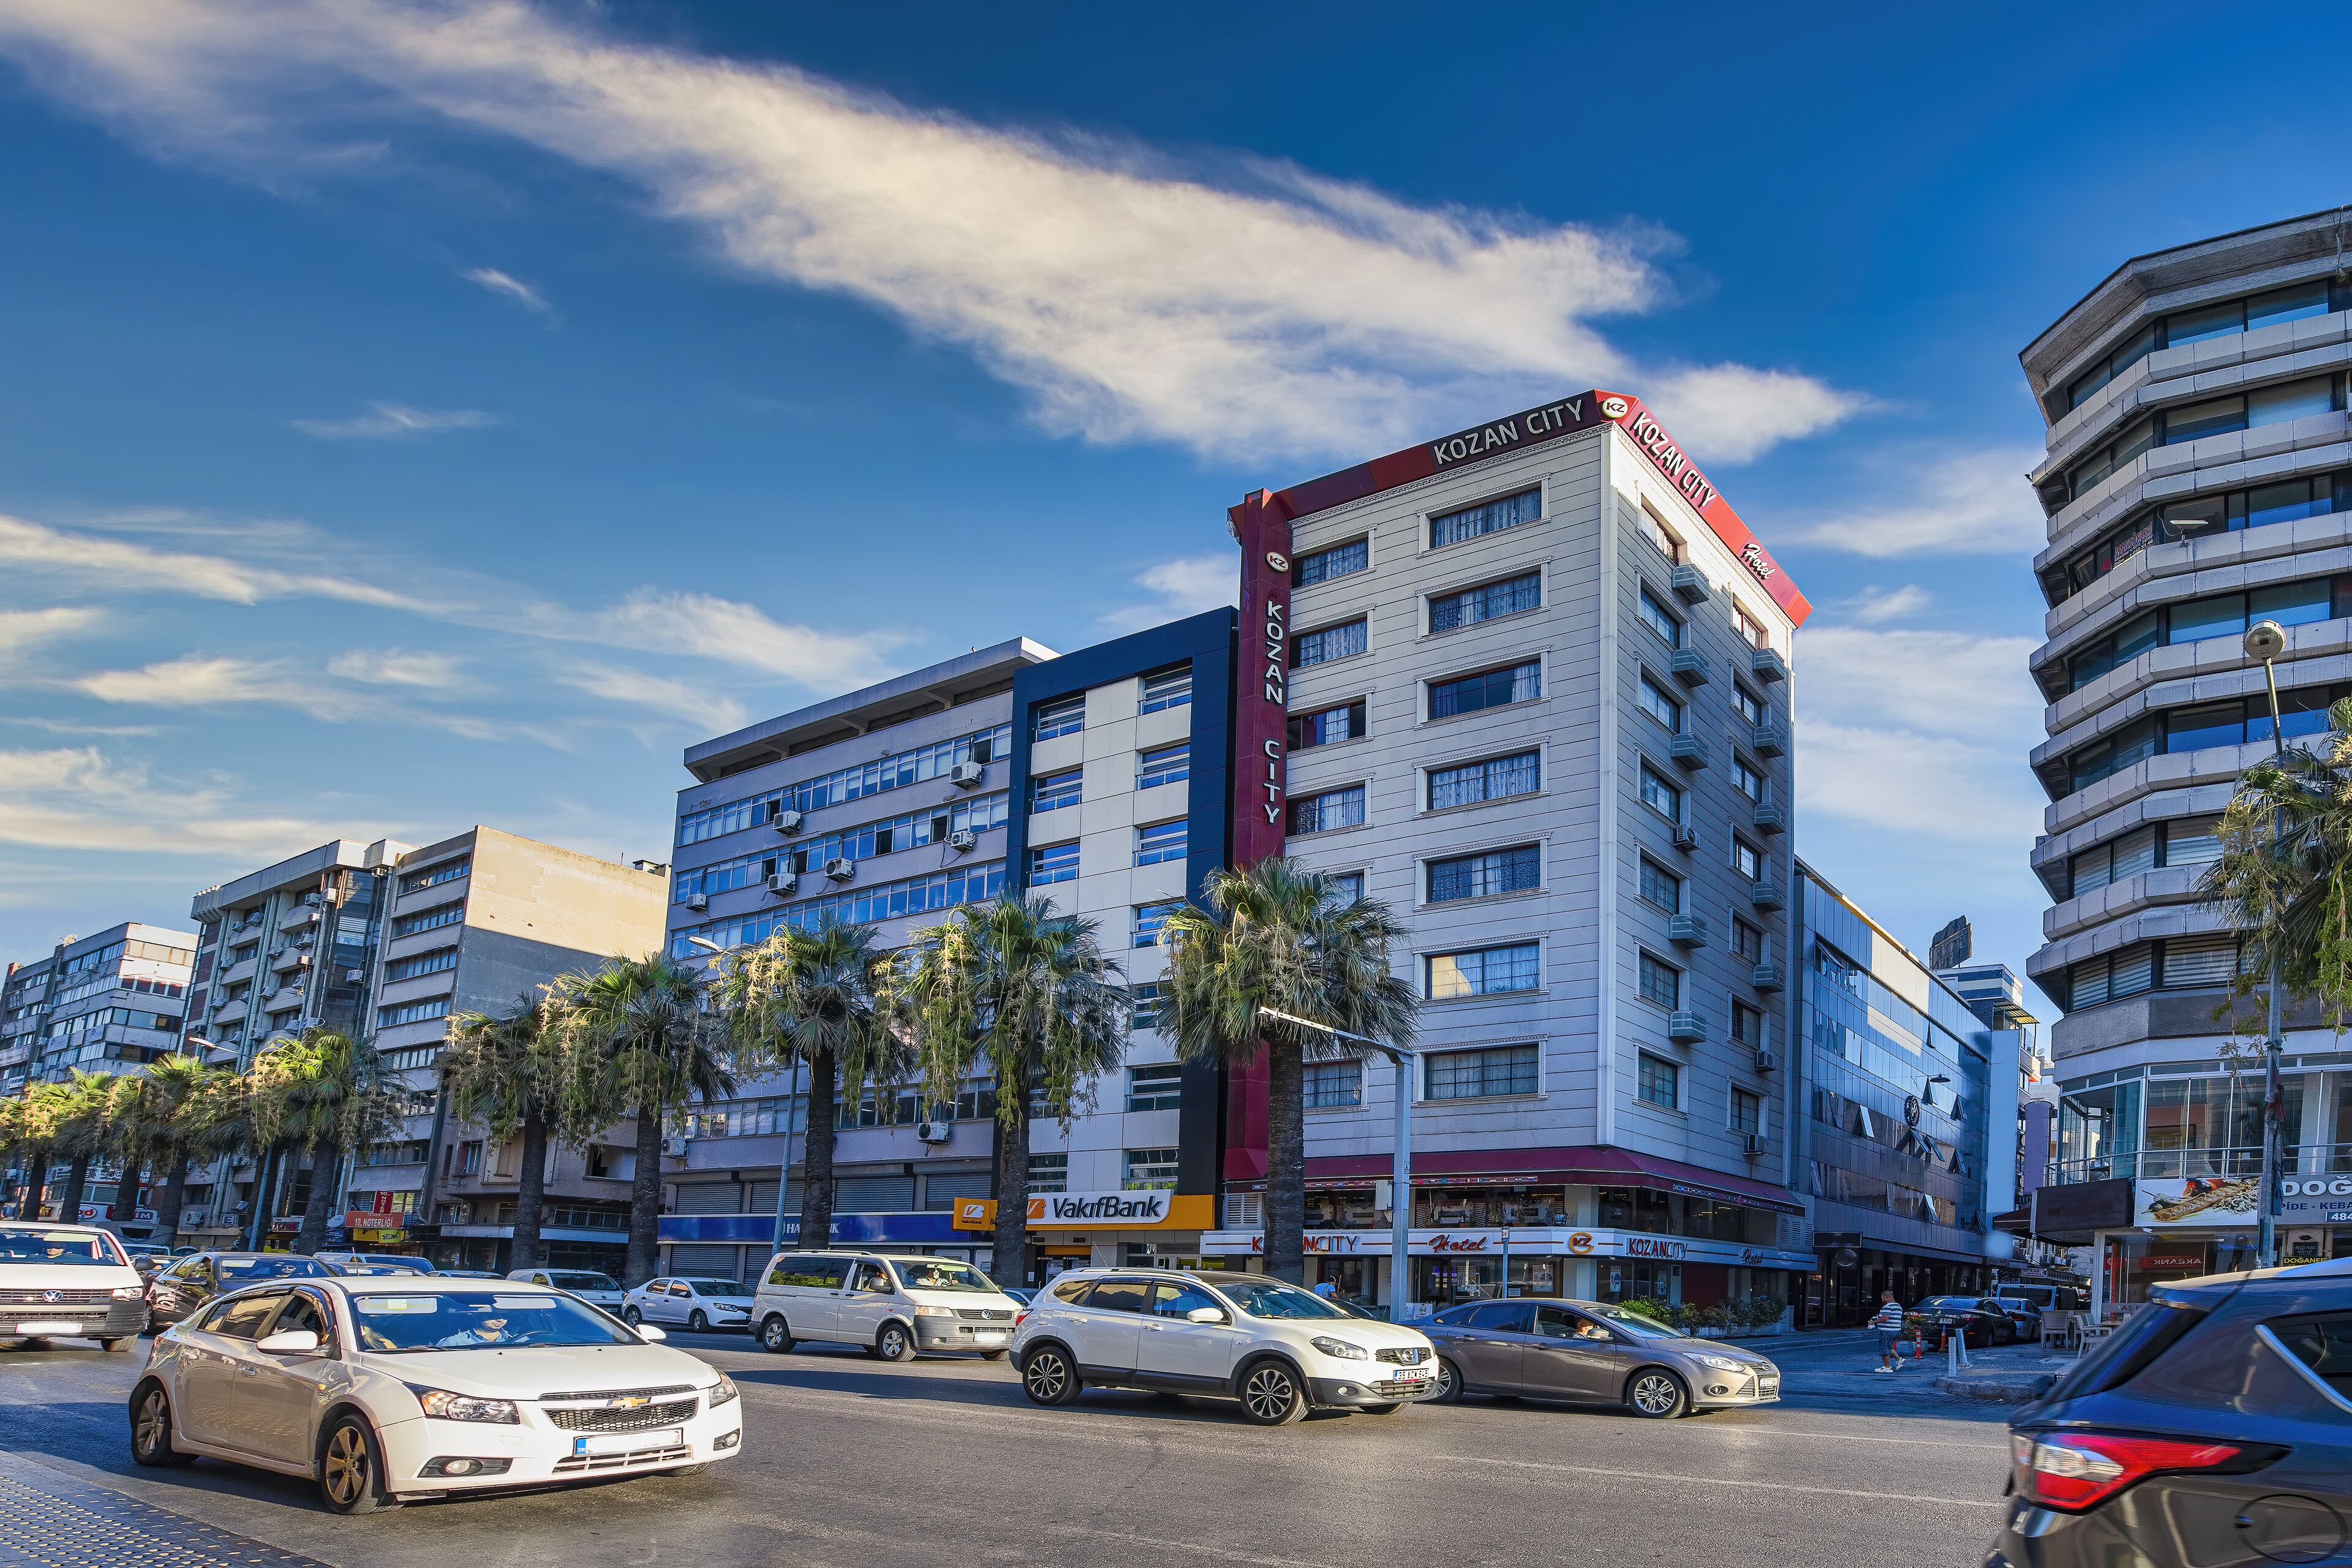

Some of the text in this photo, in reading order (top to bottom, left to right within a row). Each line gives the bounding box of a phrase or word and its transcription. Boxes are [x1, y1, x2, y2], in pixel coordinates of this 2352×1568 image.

[1606, 401, 1626, 413] KZ
[1433, 399, 1582, 465] KOZAN CITY
[1630, 411, 1717, 508] KOZAN CITY
[1268, 554, 1287, 570] KZ
[1743, 543, 1776, 579] Hotel
[1262, 600, 1283, 825] KOZAN CITY
[1053, 1196, 1163, 1219] VakıfBank
[363, 1217, 393, 1227] NOTERLİĞİ
[1428, 1234, 1488, 1254] Hotel
[1572, 1237, 1593, 1247] KZ
[1741, 1248, 1764, 1265] Hotel
